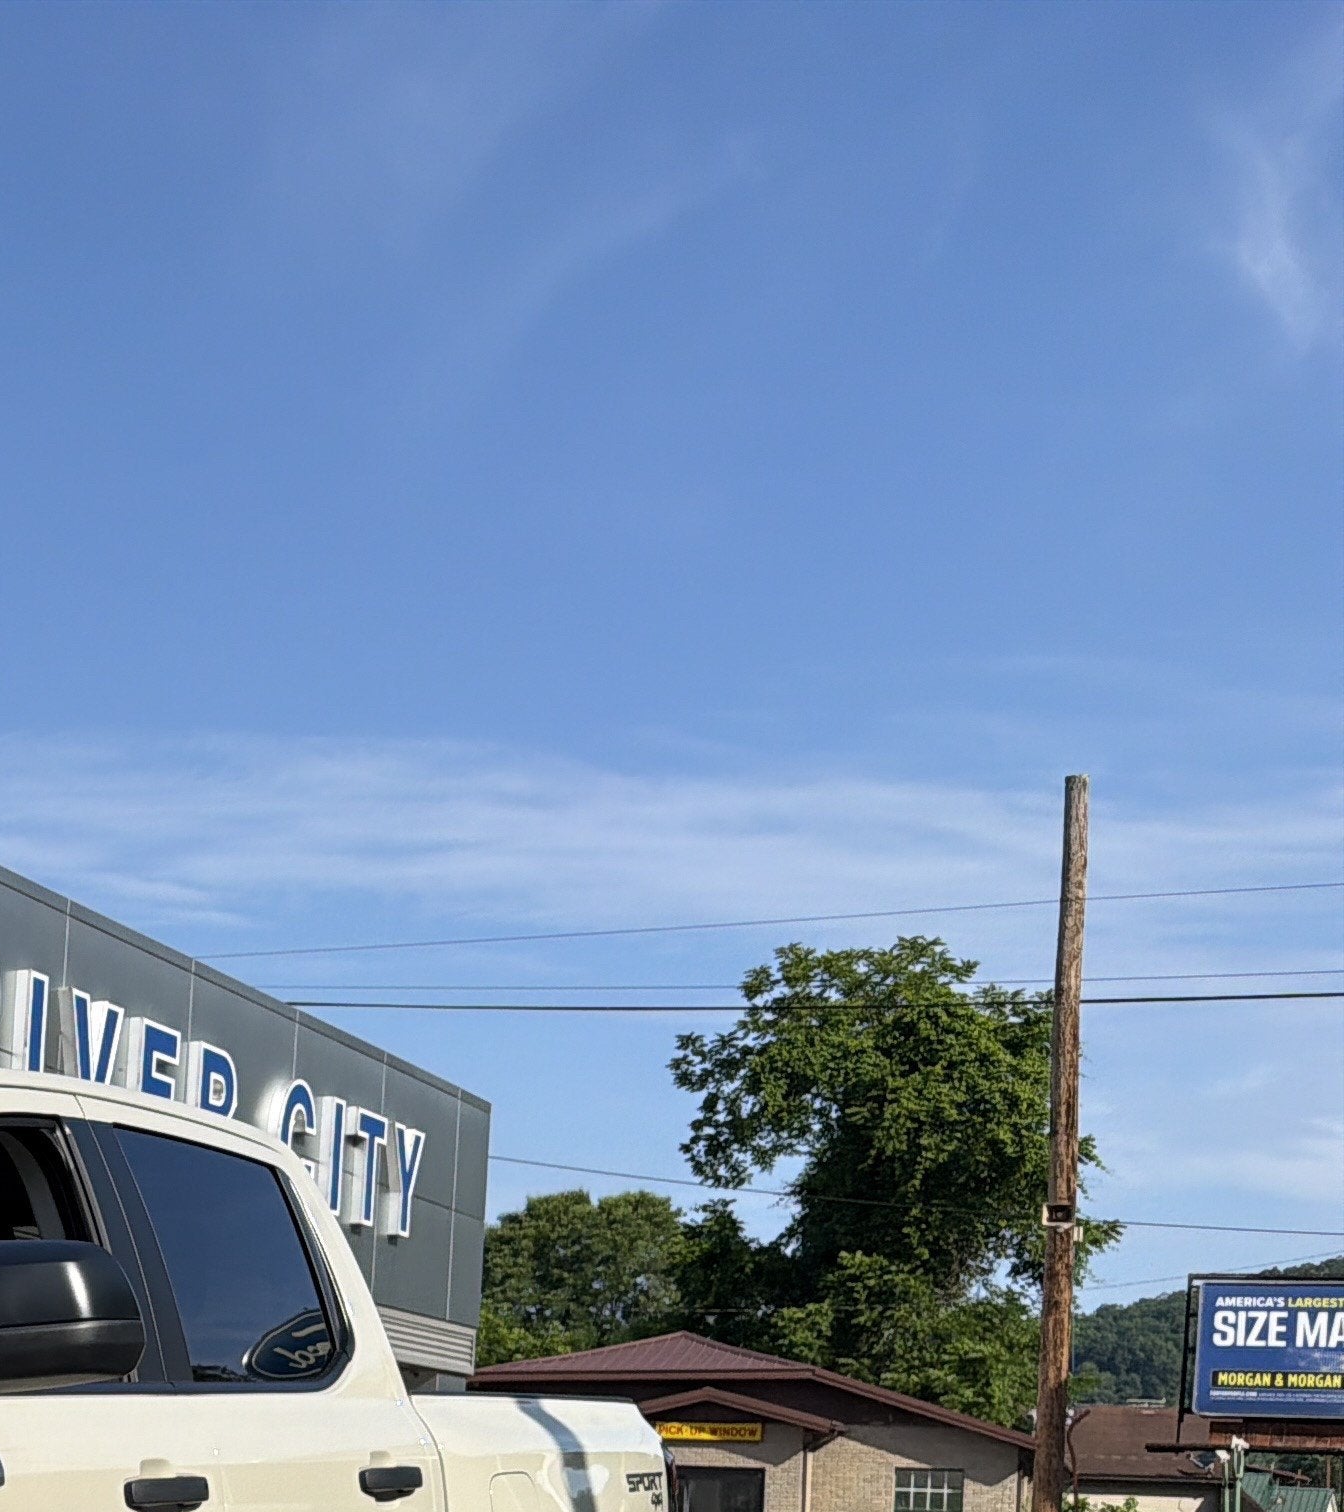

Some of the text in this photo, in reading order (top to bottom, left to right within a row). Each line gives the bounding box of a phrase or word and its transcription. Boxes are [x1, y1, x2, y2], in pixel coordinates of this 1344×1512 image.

[1215, 1296, 1344, 1308] AMERICA'S LARGEST
[1212, 1310, 1289, 1347] SIZE
[1217, 1371, 1342, 1389] MORGAN & MORGAN
[709, 1426, 758, 1437] WINDOW
[625, 1471, 663, 1493] SPORT
